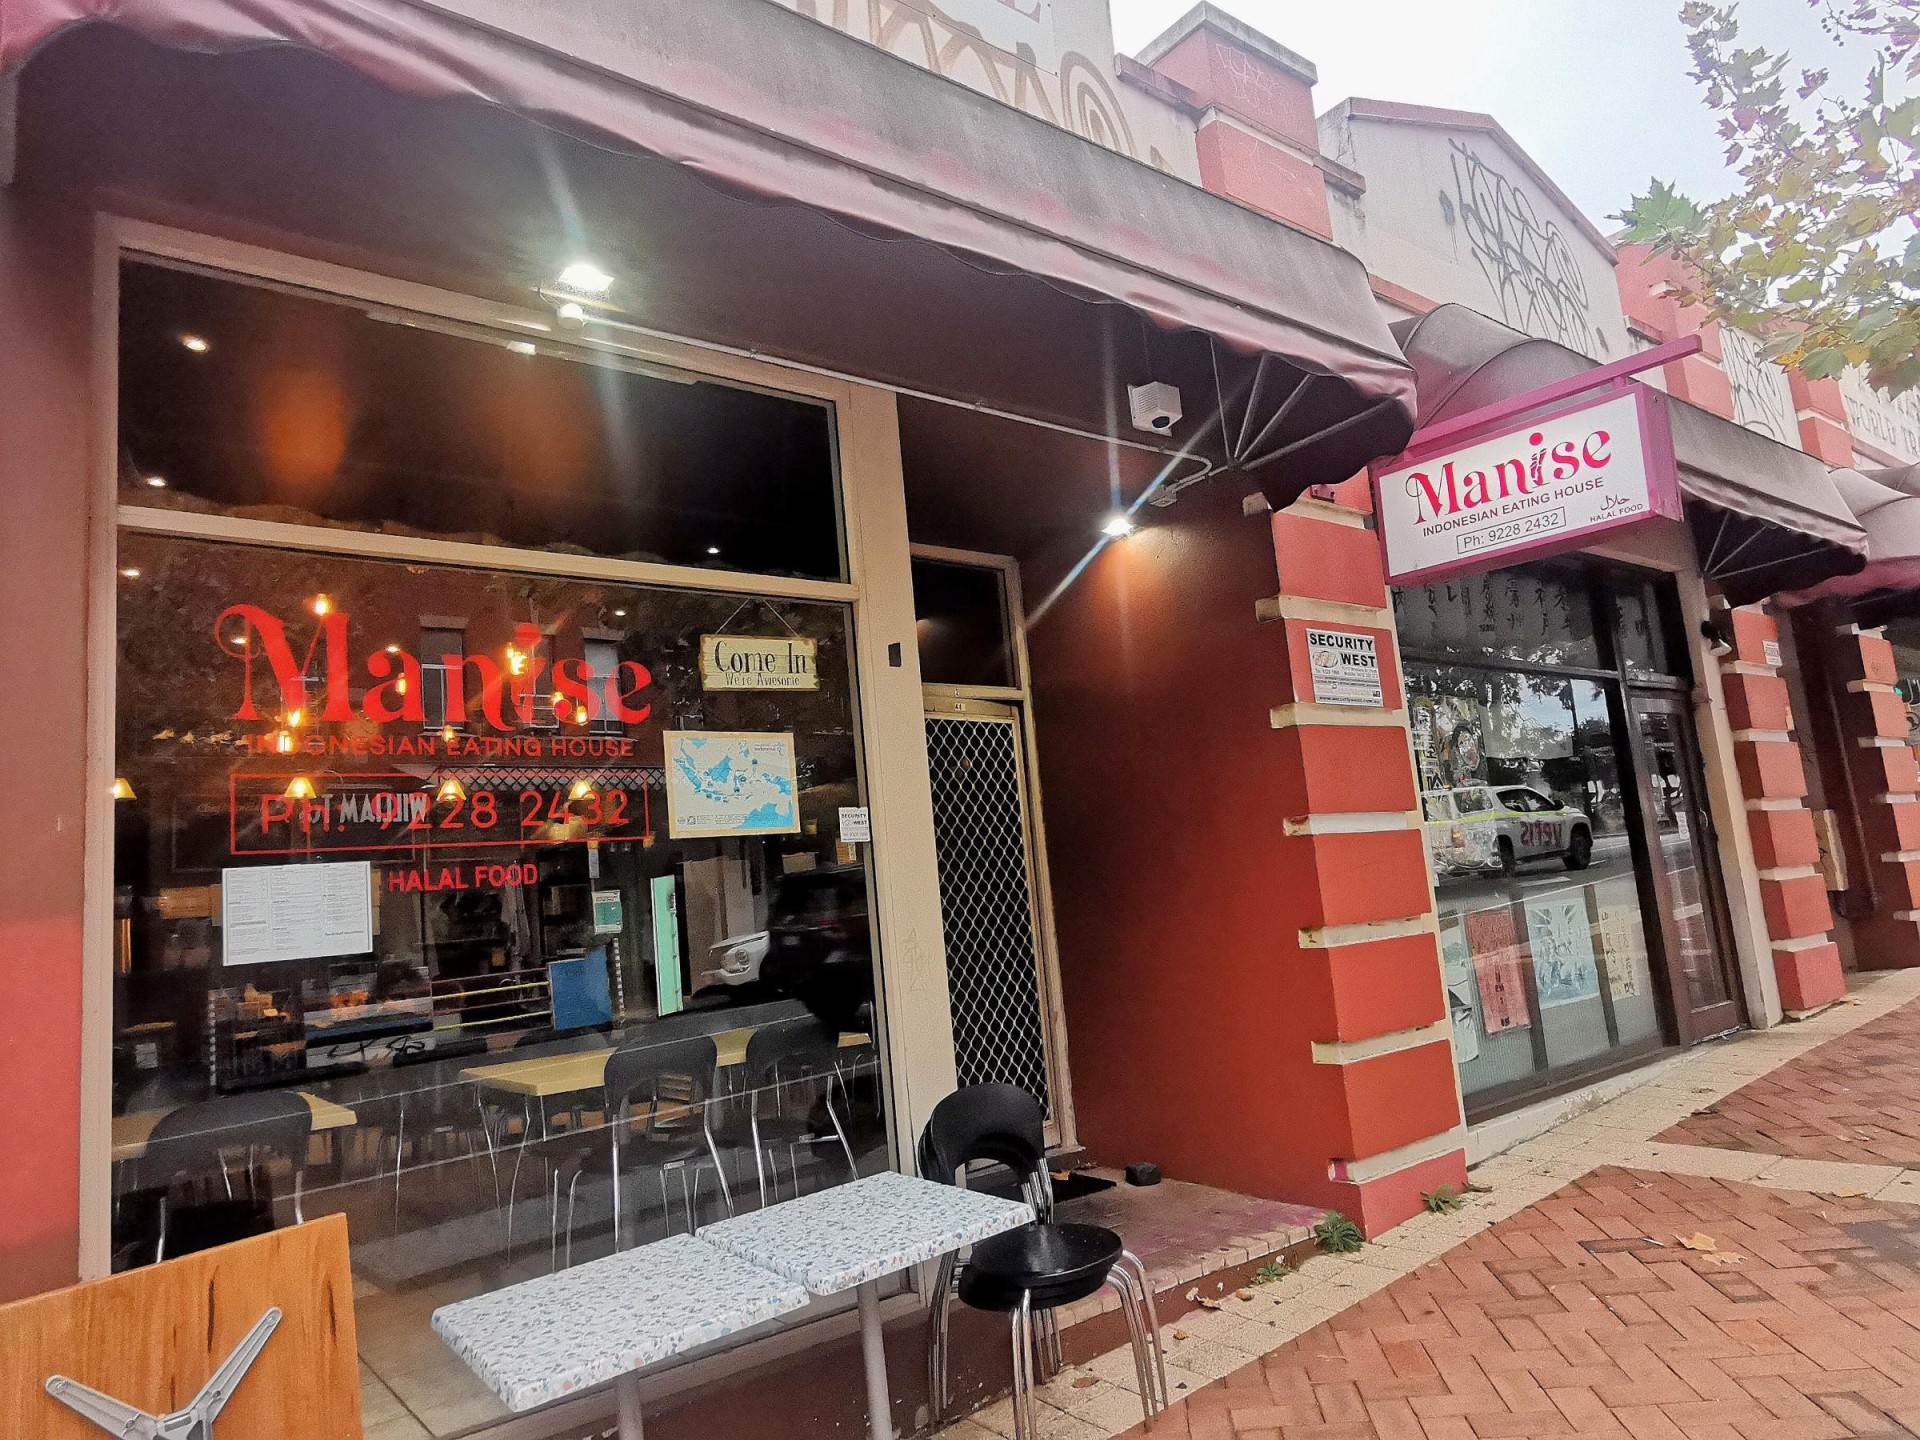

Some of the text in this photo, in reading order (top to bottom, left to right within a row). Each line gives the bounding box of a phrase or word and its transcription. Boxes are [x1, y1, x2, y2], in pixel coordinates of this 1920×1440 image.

[1405, 430, 1612, 525] Manise
[1422, 476, 1604, 538] INDONESIAN EATING HOUSE
[1589, 503, 1644, 523] HALAL FOOD
[1462, 514, 1560, 550] Ph: 9228 2432
[714, 640, 808, 674] Come In
[1309, 633, 1374, 651] SECURITY
[214, 604, 652, 731] Manise
[1340, 652, 1376, 668] WEST
[756, 673, 800, 686] Awesome
[246, 733, 634, 757] INONESIAN EATING HOUSE
[261, 790, 629, 833] Ph: 9228 2432
[388, 864, 538, 893] HALAL FOOD
